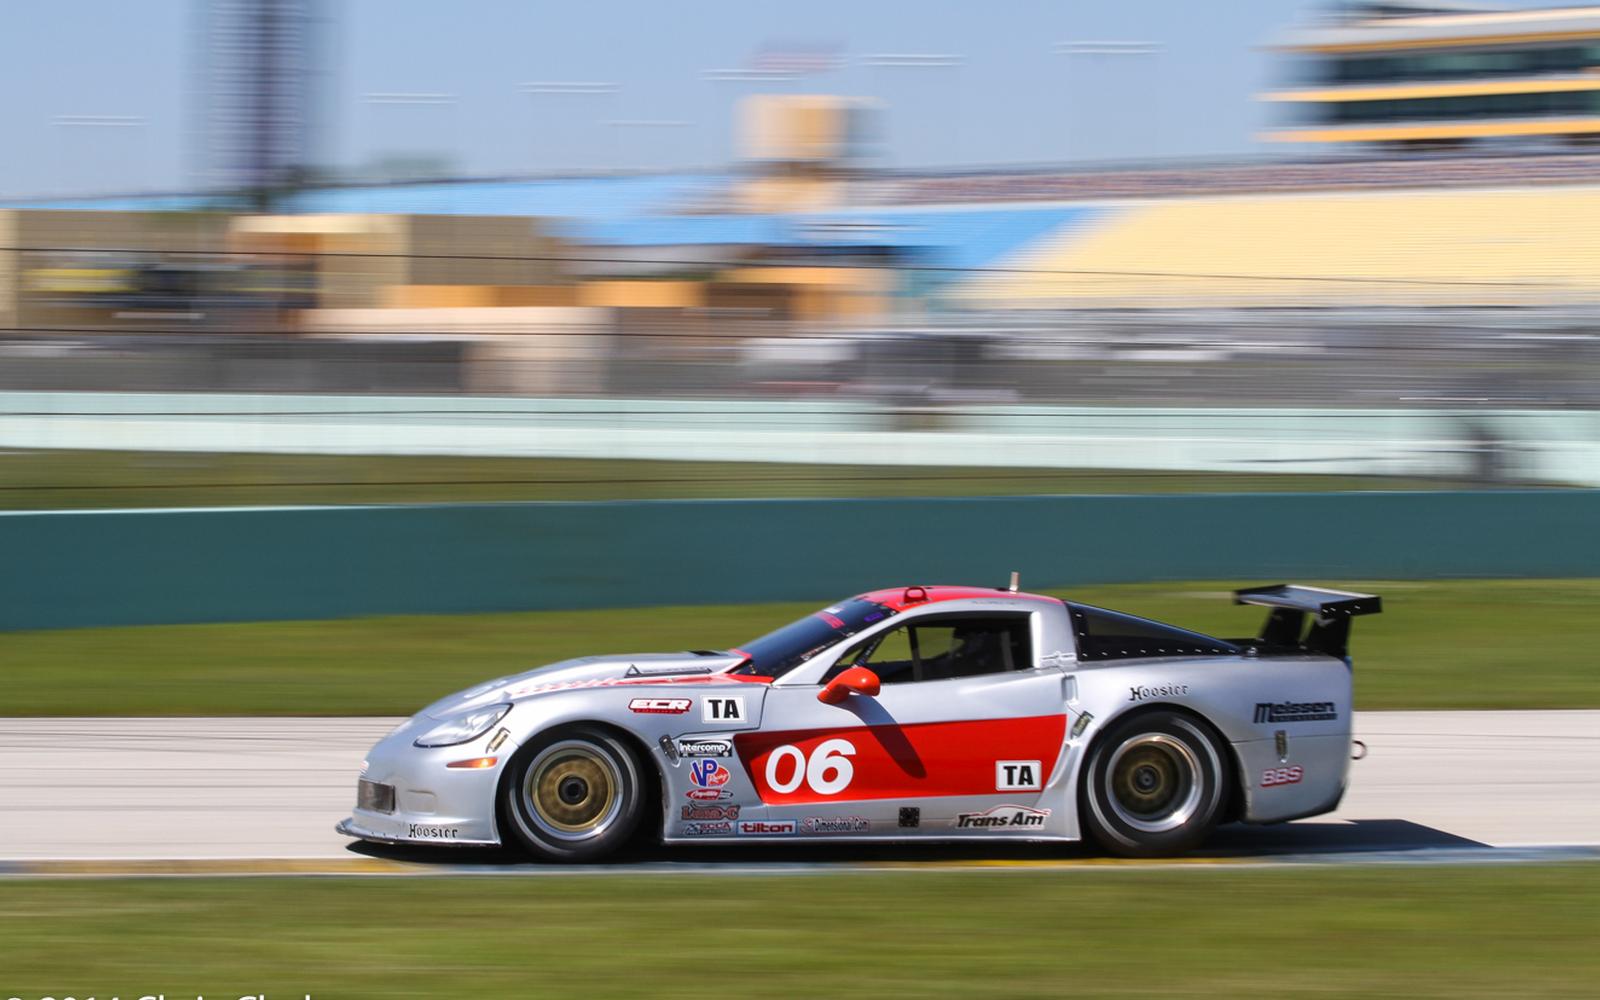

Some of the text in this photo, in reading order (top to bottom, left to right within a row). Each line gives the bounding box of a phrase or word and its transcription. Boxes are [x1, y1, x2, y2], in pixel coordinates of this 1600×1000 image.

[1129, 682, 1188, 701] Hoosier
[629, 699, 691, 710] ECR
[708, 699, 740, 718] TA
[1254, 701, 1335, 723] Meissen
[692, 759, 718, 786] VP
[765, 738, 856, 795] 06
[1003, 765, 1034, 785] TA
[1261, 766, 1304, 786] BBS
[741, 822, 793, 833] tilton
[957, 812, 1043, 827] Trans Am
[408, 823, 458, 838] Hoosier
